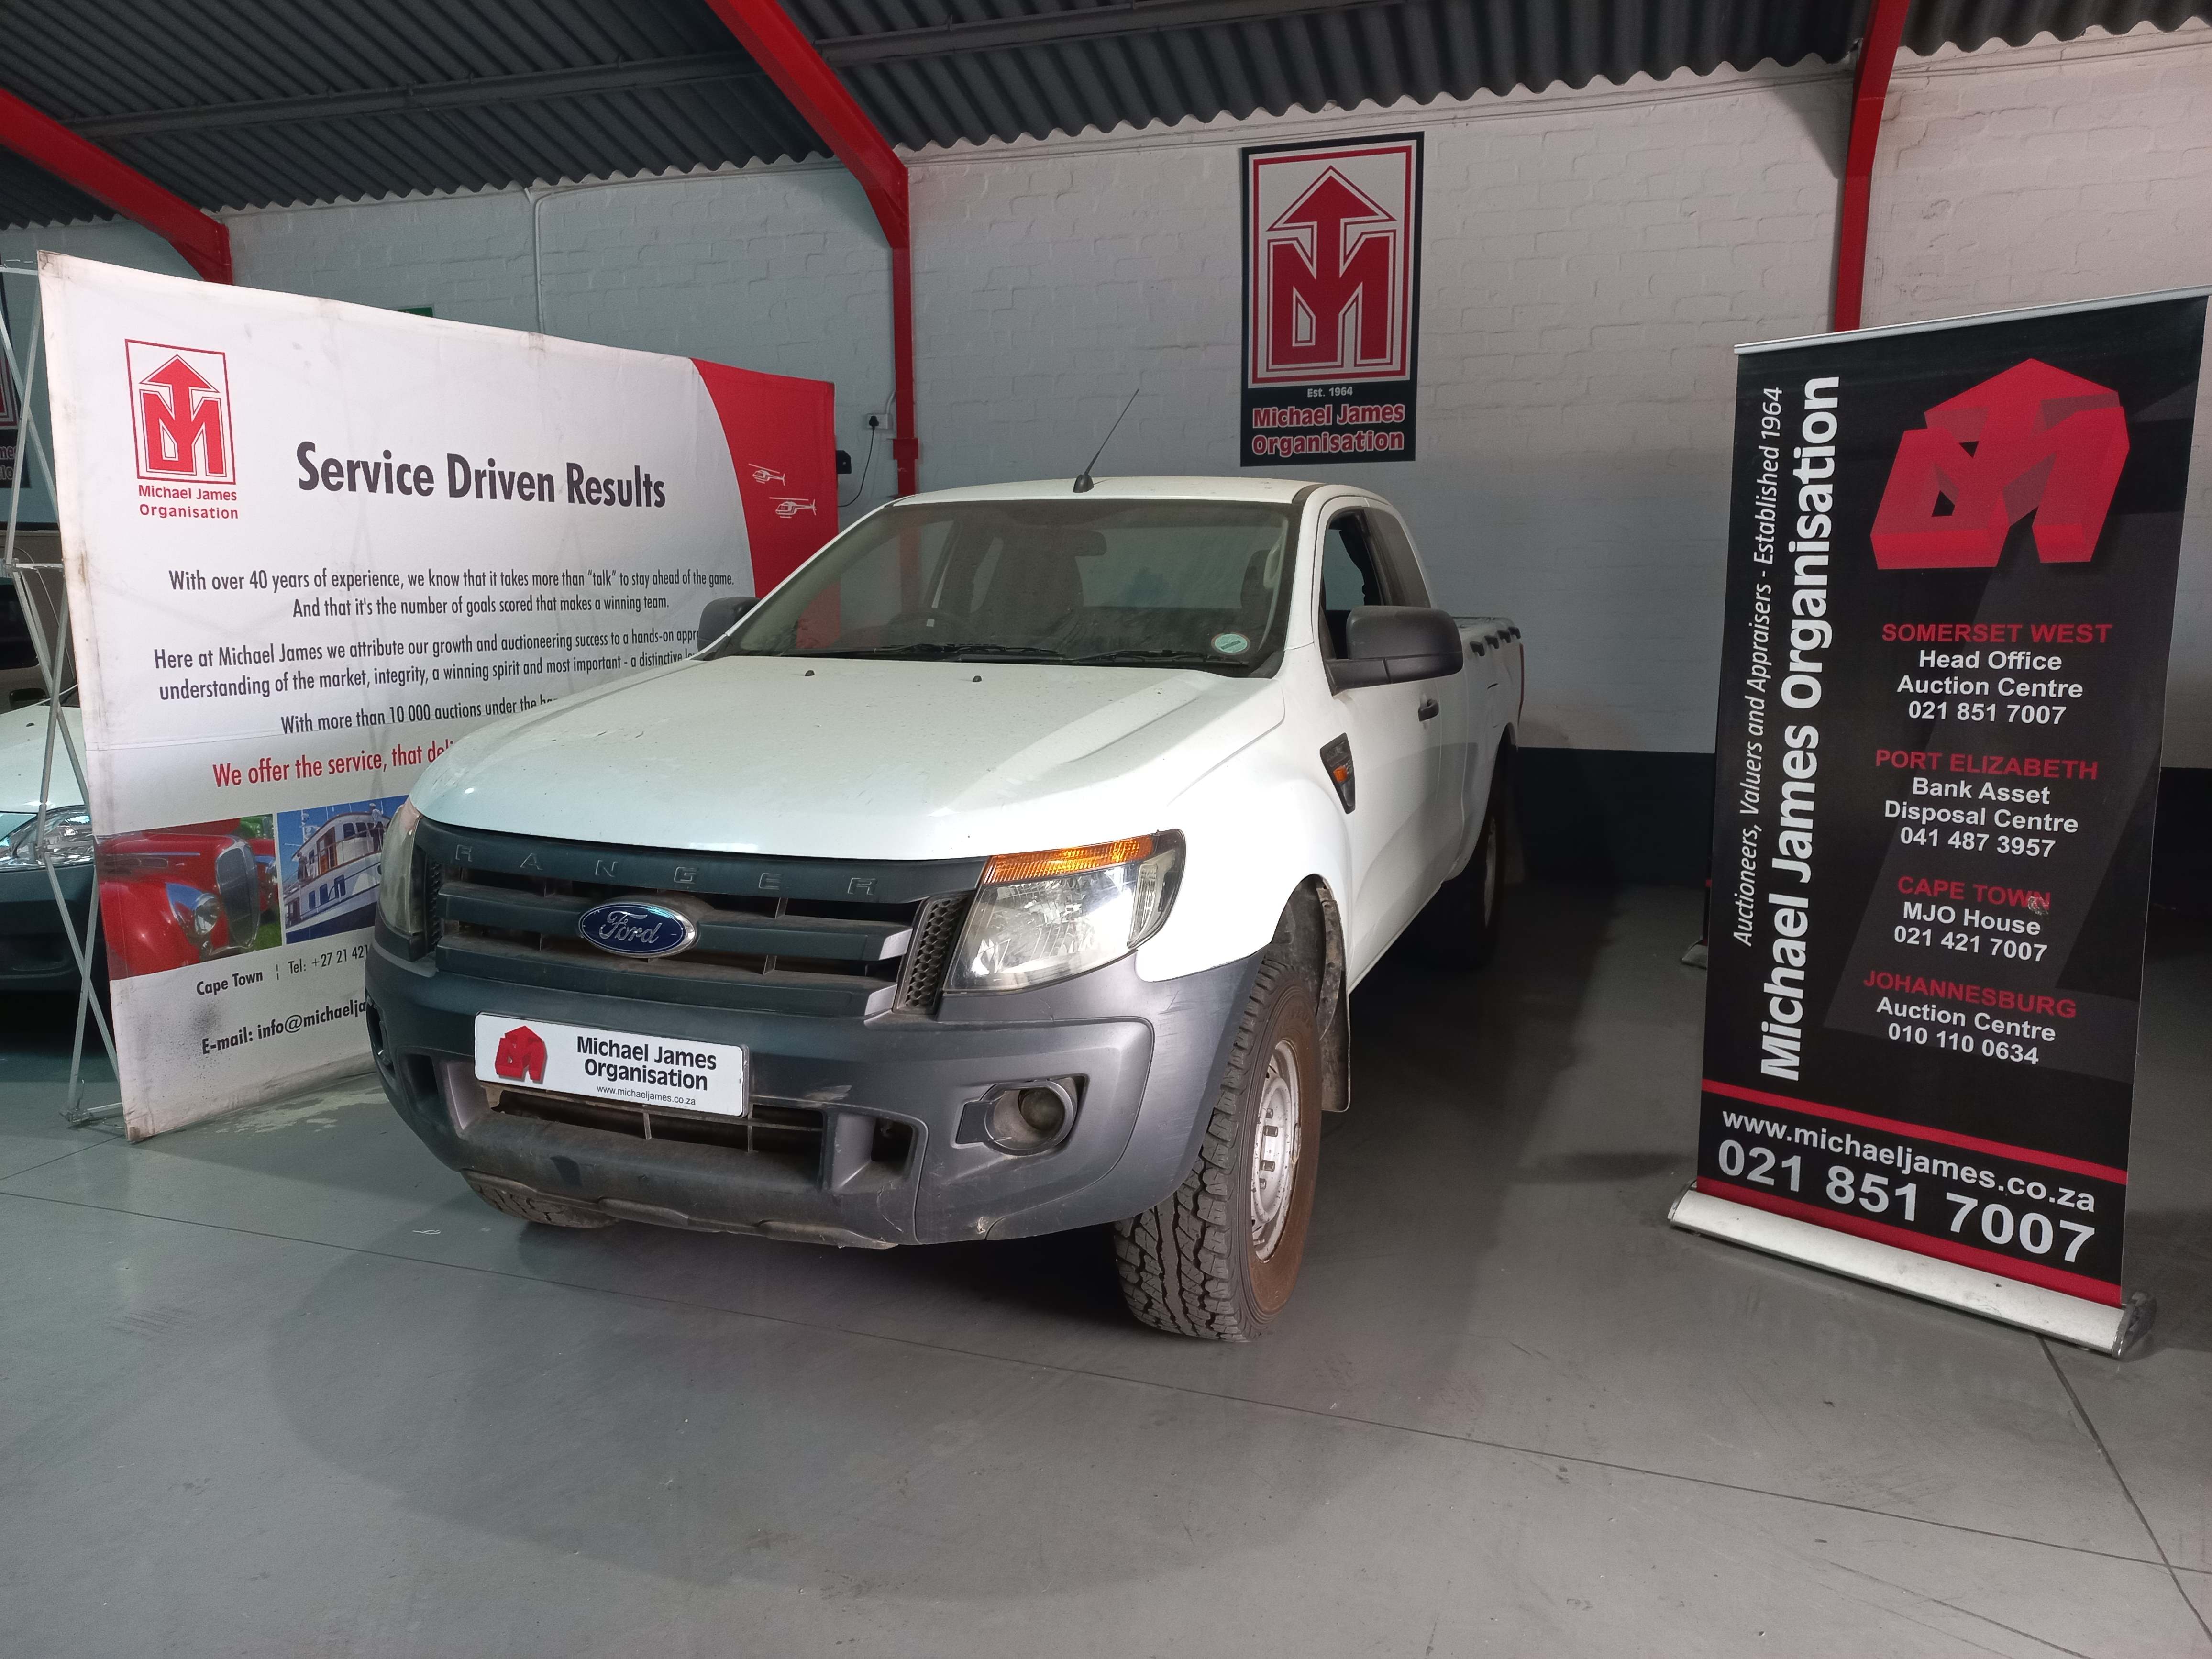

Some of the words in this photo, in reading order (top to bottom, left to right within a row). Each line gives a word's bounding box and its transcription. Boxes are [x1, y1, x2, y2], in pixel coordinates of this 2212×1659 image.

[1307, 388, 1325, 397] Est.
[1329, 387, 1352, 396] 1964
[1253, 404, 1332, 428] Michael
[1337, 404, 1405, 425] James
[1761, 387, 1782, 439] 1964
[1252, 430, 1404, 457] Organisation
[139, 485, 191, 499] Michael
[196, 489, 237, 500] James
[297, 442, 434, 496] Service
[447, 453, 554, 502] Driven
[567, 463, 665, 508] Results
[140, 504, 238, 519] Organisation
[1754, 446, 1779, 564] Established
[1781, 377, 1839, 708] Organisation
[169, 570, 206, 590] With
[212, 576, 244, 589] over
[250, 570, 267, 589] 40
[272, 575, 309, 593] years
[314, 568, 327, 587] of
[332, 570, 403, 591] experience,
[408, 575, 424, 586] we
[429, 569, 459, 586] know
[464, 569, 486, 586] that
[490, 571, 497, 586] it
[500, 569, 528, 586] takes
[532, 575, 558, 586] more
[562, 570, 584, 586] than
[620, 573, 629, 586] to
[632, 573, 649, 588] stay
[653, 569, 679, 585] ahead
[683, 569, 690, 584] of
[693, 569, 706, 584] the
[709, 575, 733, 587] game.
[293, 597, 320, 617] And
[324, 597, 351, 616] that
[355, 598, 372, 615] it's
[376, 596, 396, 614] the
[401, 596, 447, 614] number
[452, 596, 462, 613] of
[467, 596, 496, 617] goals
[500, 595, 532, 612] scored
[536, 595, 556, 611] that
[561, 595, 591, 610] makes
[595, 600, 600, 610] a
[604, 596, 641, 612] winning
[644, 596, 669, 608] team.
[155, 649, 192, 668] Here
[199, 650, 213, 667] at
[220, 643, 274, 666] Michael
[279, 644, 322, 662] James
[327, 646, 345, 658] we
[350, 638, 404, 657] attribute
[409, 642, 428, 654] our
[433, 635, 472, 657] growth
[477, 634, 497, 651] and
[501, 633, 572, 651] auctioneering
[576, 635, 608, 647] success
[611, 632, 619, 645] to
[623, 634, 628, 644] a
[632, 628, 674, 644] hands-on
[1747, 584, 1771, 692] Appraisers
[1882, 624, 2022, 642] SOMERSET
[2031, 624, 2112, 643] WEST
[160, 675, 270, 700] understanding
[276, 672, 288, 691] of
[293, 671, 314, 690] the
[320, 667, 370, 688] market,
[375, 666, 428, 686] integrity,
[432, 669, 439, 680] a
[443, 663, 488, 681] winning
[493, 661, 520, 680] spirit
[524, 657, 542, 675] and
[547, 659, 570, 673] most
[574, 656, 621, 674] important
[631, 657, 636, 667] a
[640, 651, 682, 666] distinctive
[1920, 650, 1980, 668] Head
[1989, 651, 2061, 670] Office
[1897, 675, 1989, 695] Auction
[1998, 678, 2082, 697] Centre
[281, 713, 313, 734] With
[318, 716, 352, 730] more
[356, 708, 385, 726] than
[390, 706, 404, 723] 10
[409, 704, 430, 722] 000
[435, 703, 481, 719] auctions
[486, 697, 517, 715] under
[520, 696, 536, 711] the
[1745, 696, 1764, 735] and
[1909, 701, 1946, 719] 021
[1958, 703, 1995, 721] 851
[2007, 705, 2066, 724] 7007
[213, 763, 241, 787] We
[248, 758, 289, 783] offer
[295, 755, 322, 778] the
[328, 751, 387, 774] service,
[392, 744, 422, 766] that
[1740, 741, 1762, 814] Valuers
[1876, 750, 1942, 769] PORT
[1950, 754, 2097, 779] ELIZABETH
[1772, 726, 1818, 883] James
[1913, 777, 1972, 798] Bank
[1979, 782, 2050, 804] Asset
[1885, 800, 1985, 825] Disposal
[1994, 809, 2078, 832] Centre
[1901, 827, 1937, 846] 041
[1948, 831, 1989, 851] 487
[1997, 836, 2055, 857] 3957
[454, 844, 878, 896] RANGER
[1734, 825, 1762, 946] Auctioneers,
[1898, 876, 1965, 899] CAPE
[1973, 884, 2051, 911] TOWN
[599, 910, 663, 945] Ford
[1904, 902, 1955, 923] MJO
[1964, 909, 2040, 935] House
[1895, 926, 1931, 946] 021
[1941, 932, 1979, 952] 421
[1991, 938, 2047, 961] 7007
[197, 980, 228, 995] Cape
[232, 972, 263, 986] Town
[288, 959, 306, 973] Tel:
[312, 952, 332, 967] +27
[337, 949, 346, 963] 21
[352, 945, 368, 959] 421
[1761, 893, 1808, 1081] Michael
[1864, 970, 2077, 1018] JOHANNESBURG
[202, 1027, 253, 1054] E-mail:
[258, 999, 366, 1039] info@michaelja
[1877, 997, 1965, 1027] Auction
[1975, 1013, 2055, 1042] Centre
[578, 1036, 648, 1062] Michael
[654, 1047, 716, 1070] James
[1889, 1023, 1927, 1044] 010
[1937, 1031, 1973, 1052] 110
[1982, 1039, 2038, 1064] 0634
[585, 1058, 707, 1091] Organisation
[596, 1085, 695, 1106] www.michaeljames.co.za
[1722, 1110, 2095, 1213] www.michaeljames.co.za
[1719, 1140, 1801, 1192] 021
[1826, 1165, 1917, 1221] 851
[1947, 1192, 2094, 1262] 7007
